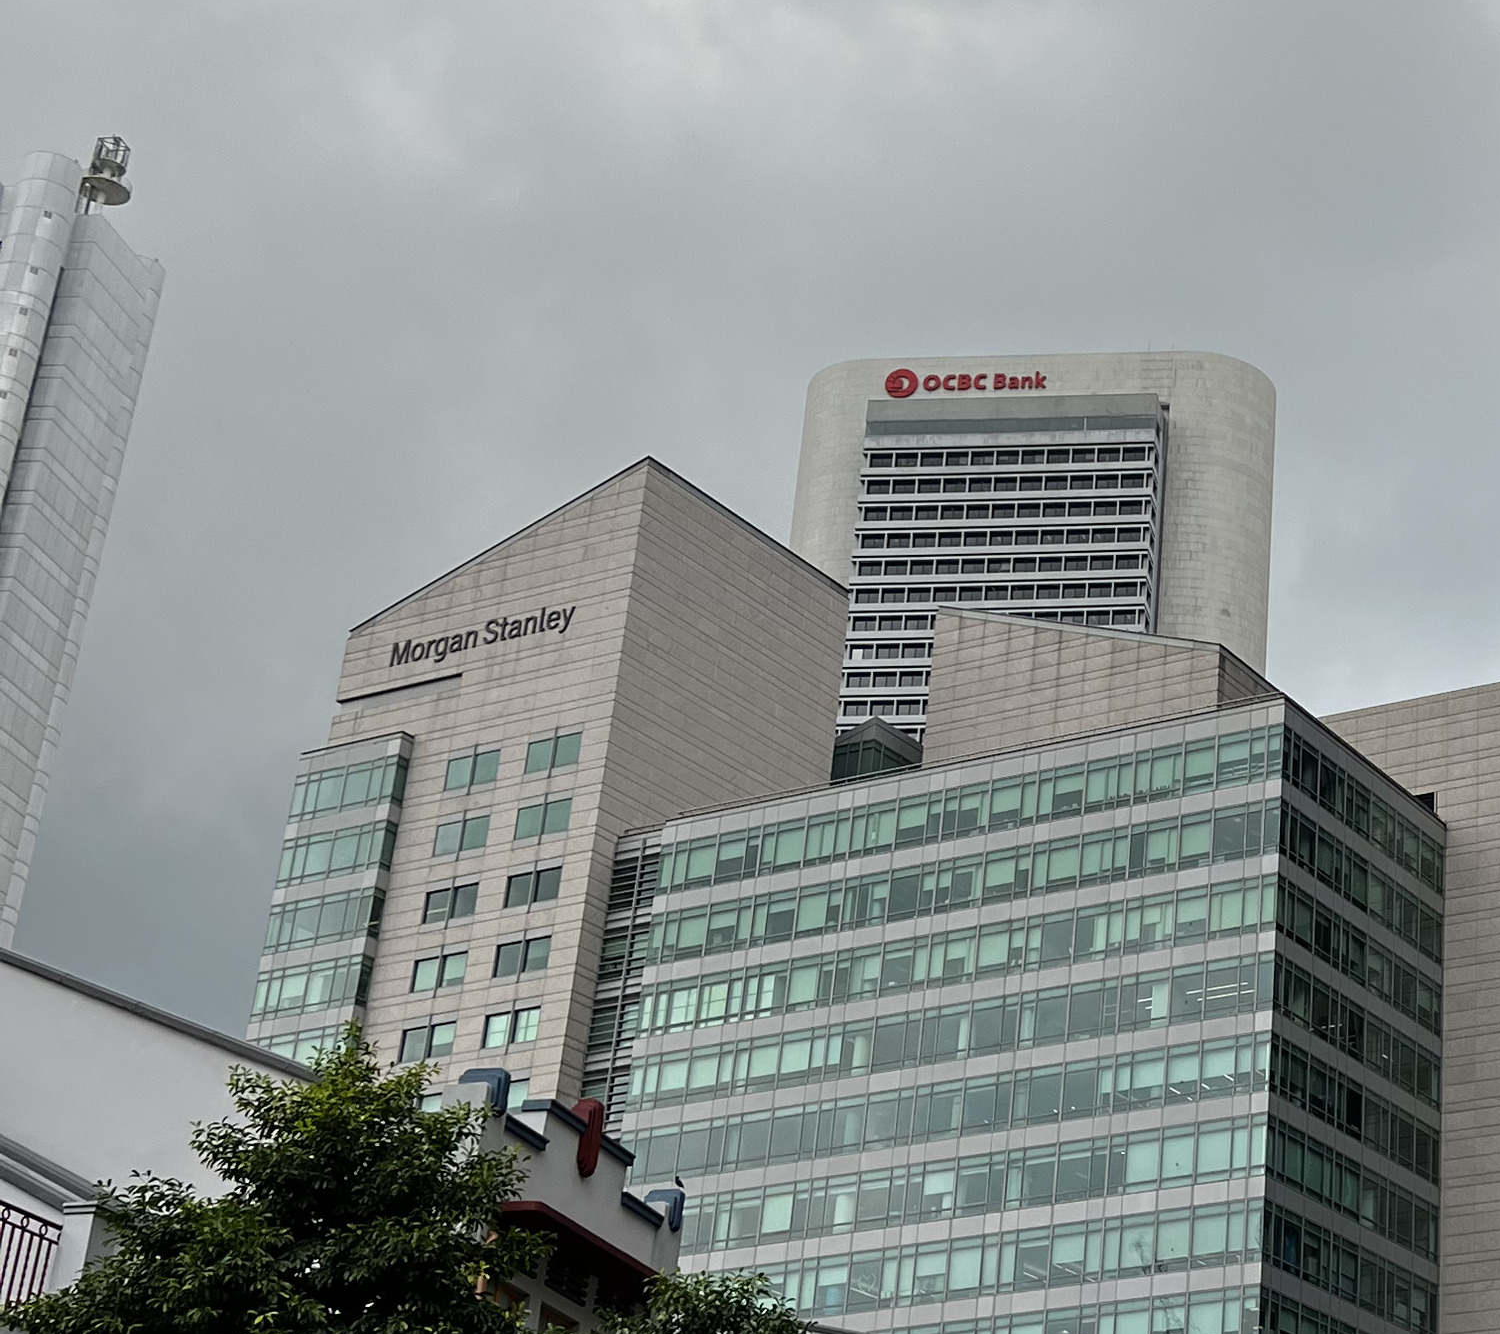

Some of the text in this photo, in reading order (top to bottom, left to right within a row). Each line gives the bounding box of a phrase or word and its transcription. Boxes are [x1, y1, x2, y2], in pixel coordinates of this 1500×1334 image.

[923, 371, 1047, 391] OCBC Bank
[389, 606, 576, 667] Morgan Stanley
